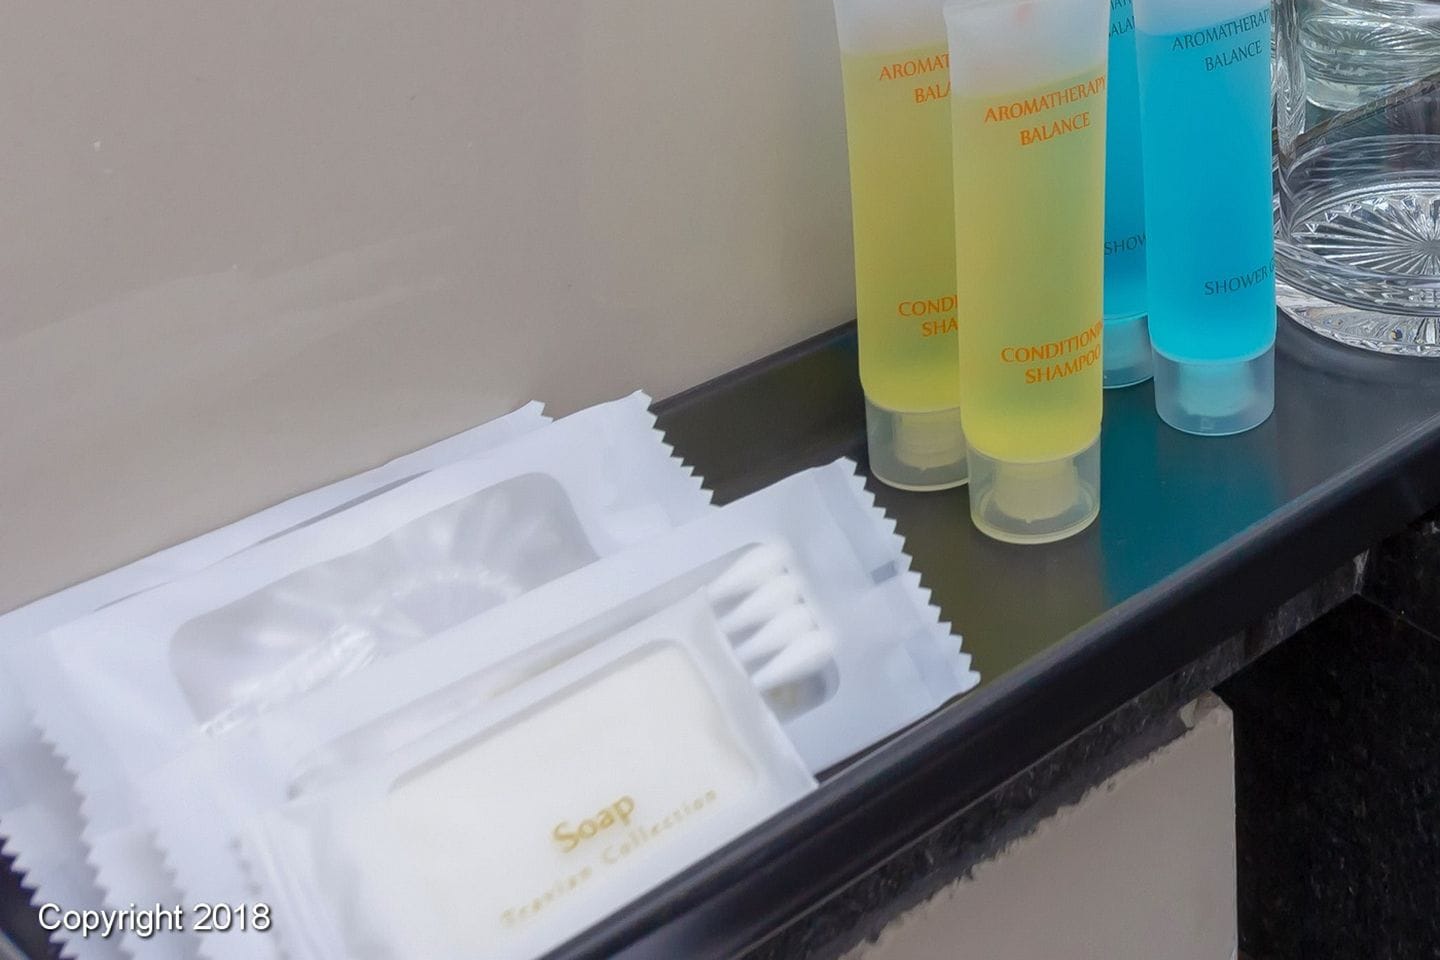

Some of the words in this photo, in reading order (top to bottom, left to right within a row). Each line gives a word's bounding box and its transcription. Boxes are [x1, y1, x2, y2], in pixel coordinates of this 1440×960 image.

[1204, 40, 1262, 72] BALANCE
[1019, 111, 1091, 146] BALANCE
[1204, 265, 1268, 296] SHOWER
[553, 795, 635, 854] Soap
